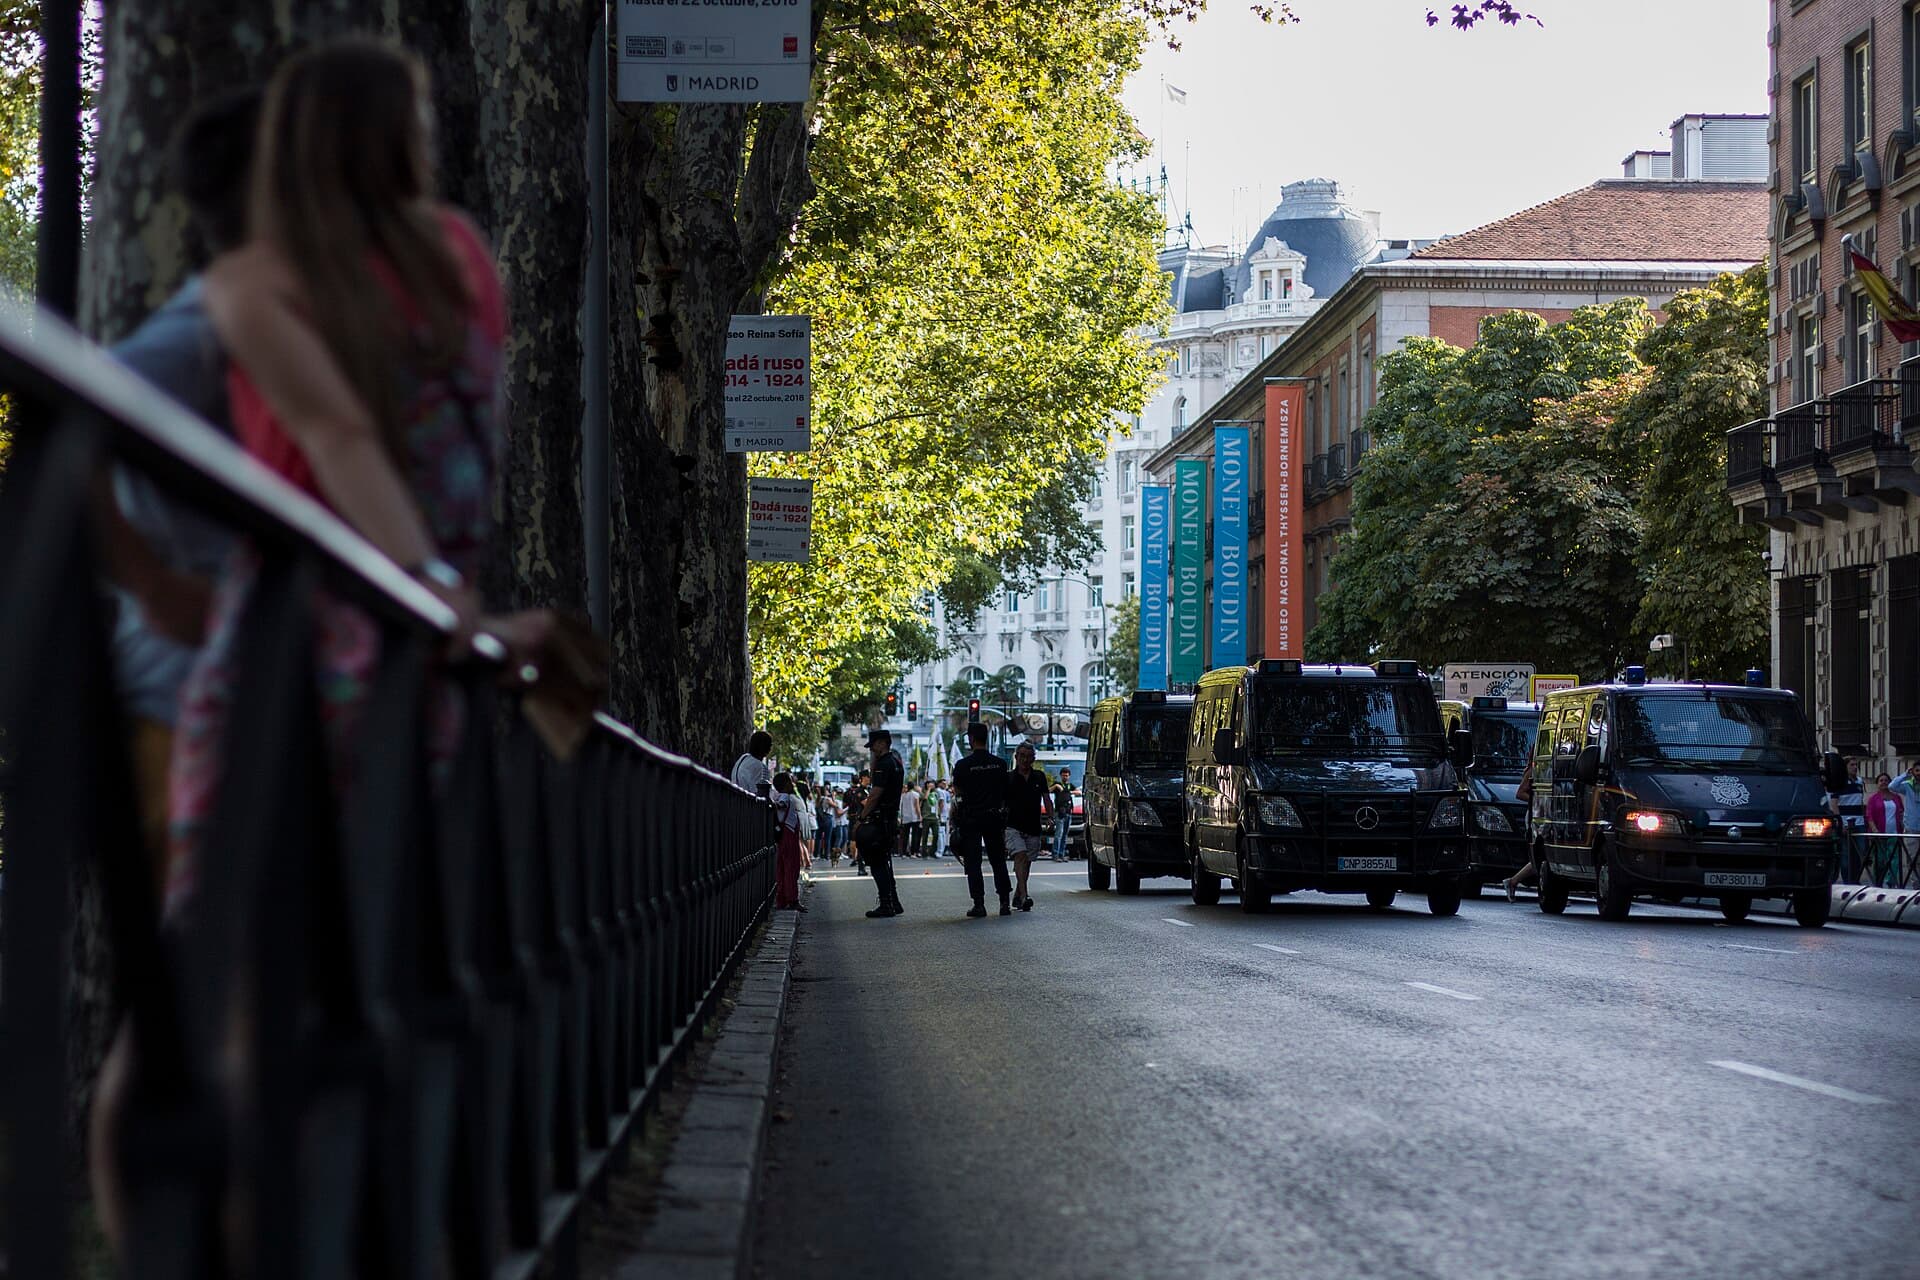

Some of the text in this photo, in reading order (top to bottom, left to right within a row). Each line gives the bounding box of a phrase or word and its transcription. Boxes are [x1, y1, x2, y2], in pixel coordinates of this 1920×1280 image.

[689, 77, 759, 90] MADRID
[747, 329, 776, 339] Reina
[726, 354, 805, 370] adá ruso
[724, 374, 749, 387] 914
[765, 374, 805, 387] 1924
[746, 438, 784, 446] MADRID
[1221, 436, 1242, 528] MONET
[783, 504, 808, 513] ruso
[1181, 467, 1199, 553] MONET
[751, 512, 774, 521] 1914
[783, 514, 808, 523] 1924
[1279, 399, 1289, 651] MUSEO NACIONAL THYSSEN-BORNEMISZA
[1147, 495, 1164, 568] MONET
[1220, 545, 1241, 645] BOUDIN
[1179, 567, 1198, 657] BOUDIN
[1145, 583, 1162, 665] BOUDIN
[1450, 669, 1529, 679] ATENCIÓN
